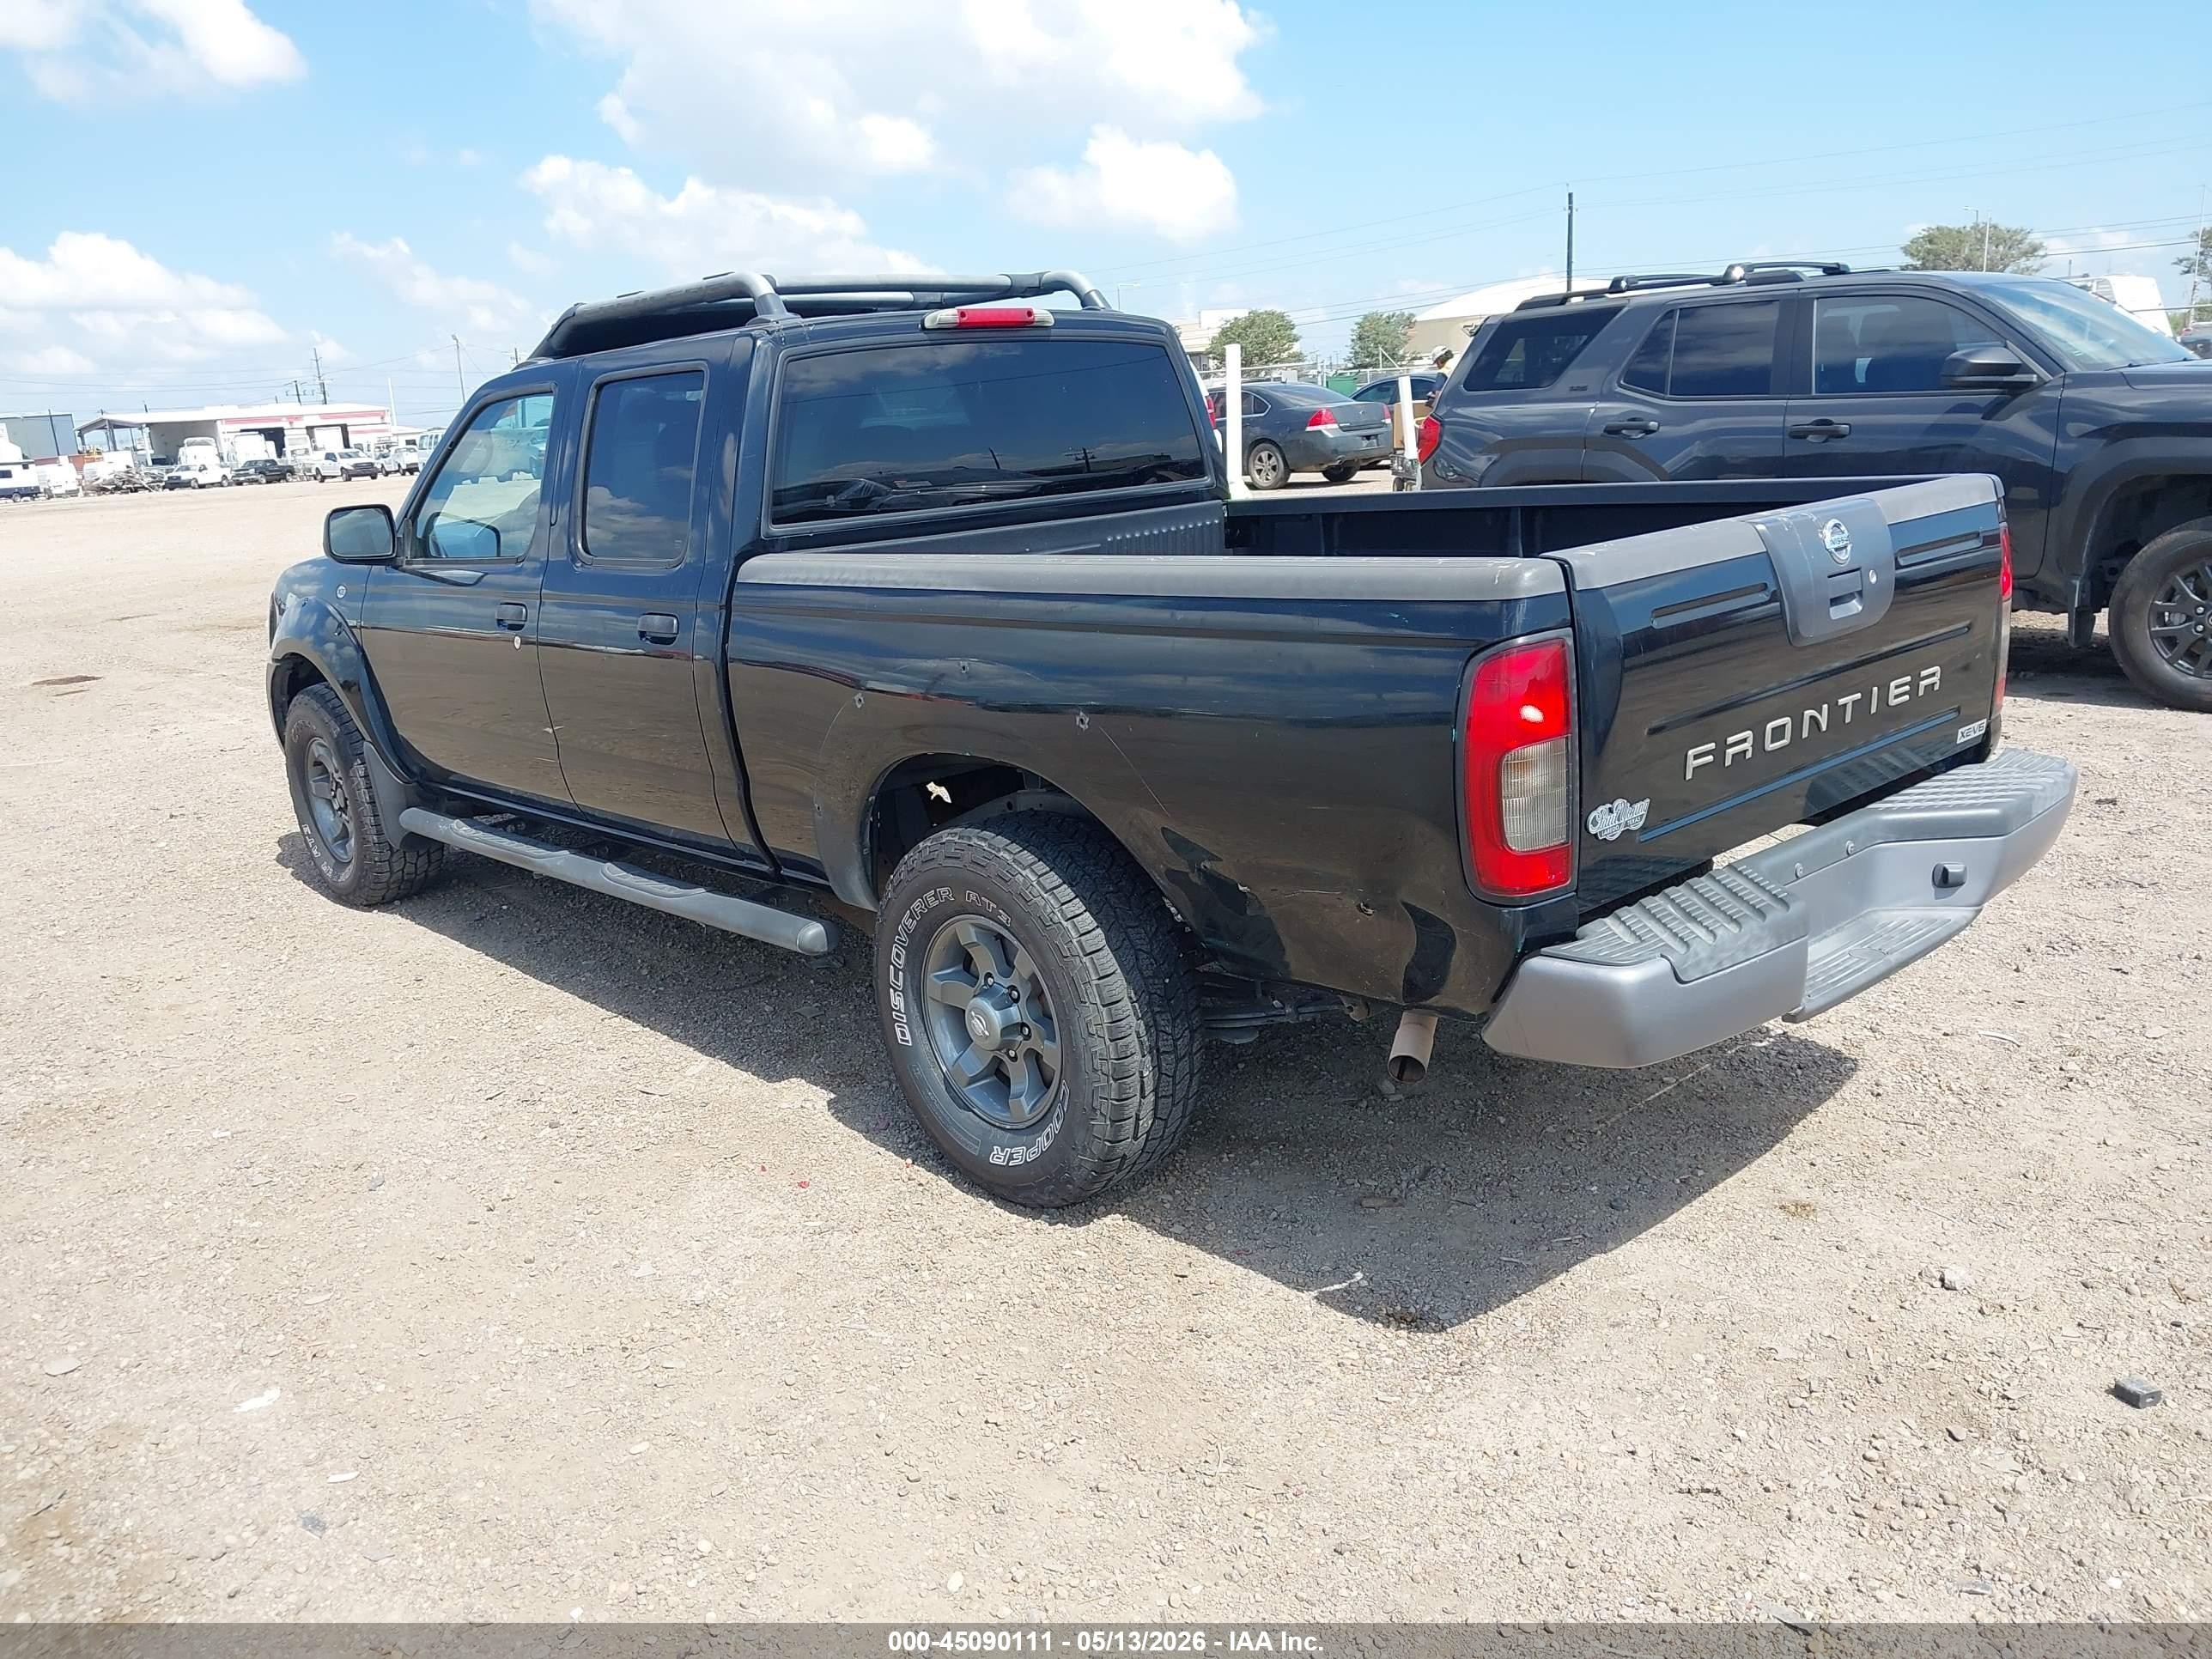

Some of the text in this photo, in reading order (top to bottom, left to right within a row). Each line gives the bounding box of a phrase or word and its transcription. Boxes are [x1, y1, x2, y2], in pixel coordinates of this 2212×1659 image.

[1684, 665, 1941, 781] FRONTIER
[890, 886, 955, 1047] DISCOVERER
[989, 1079, 1070, 1167] COOPER
